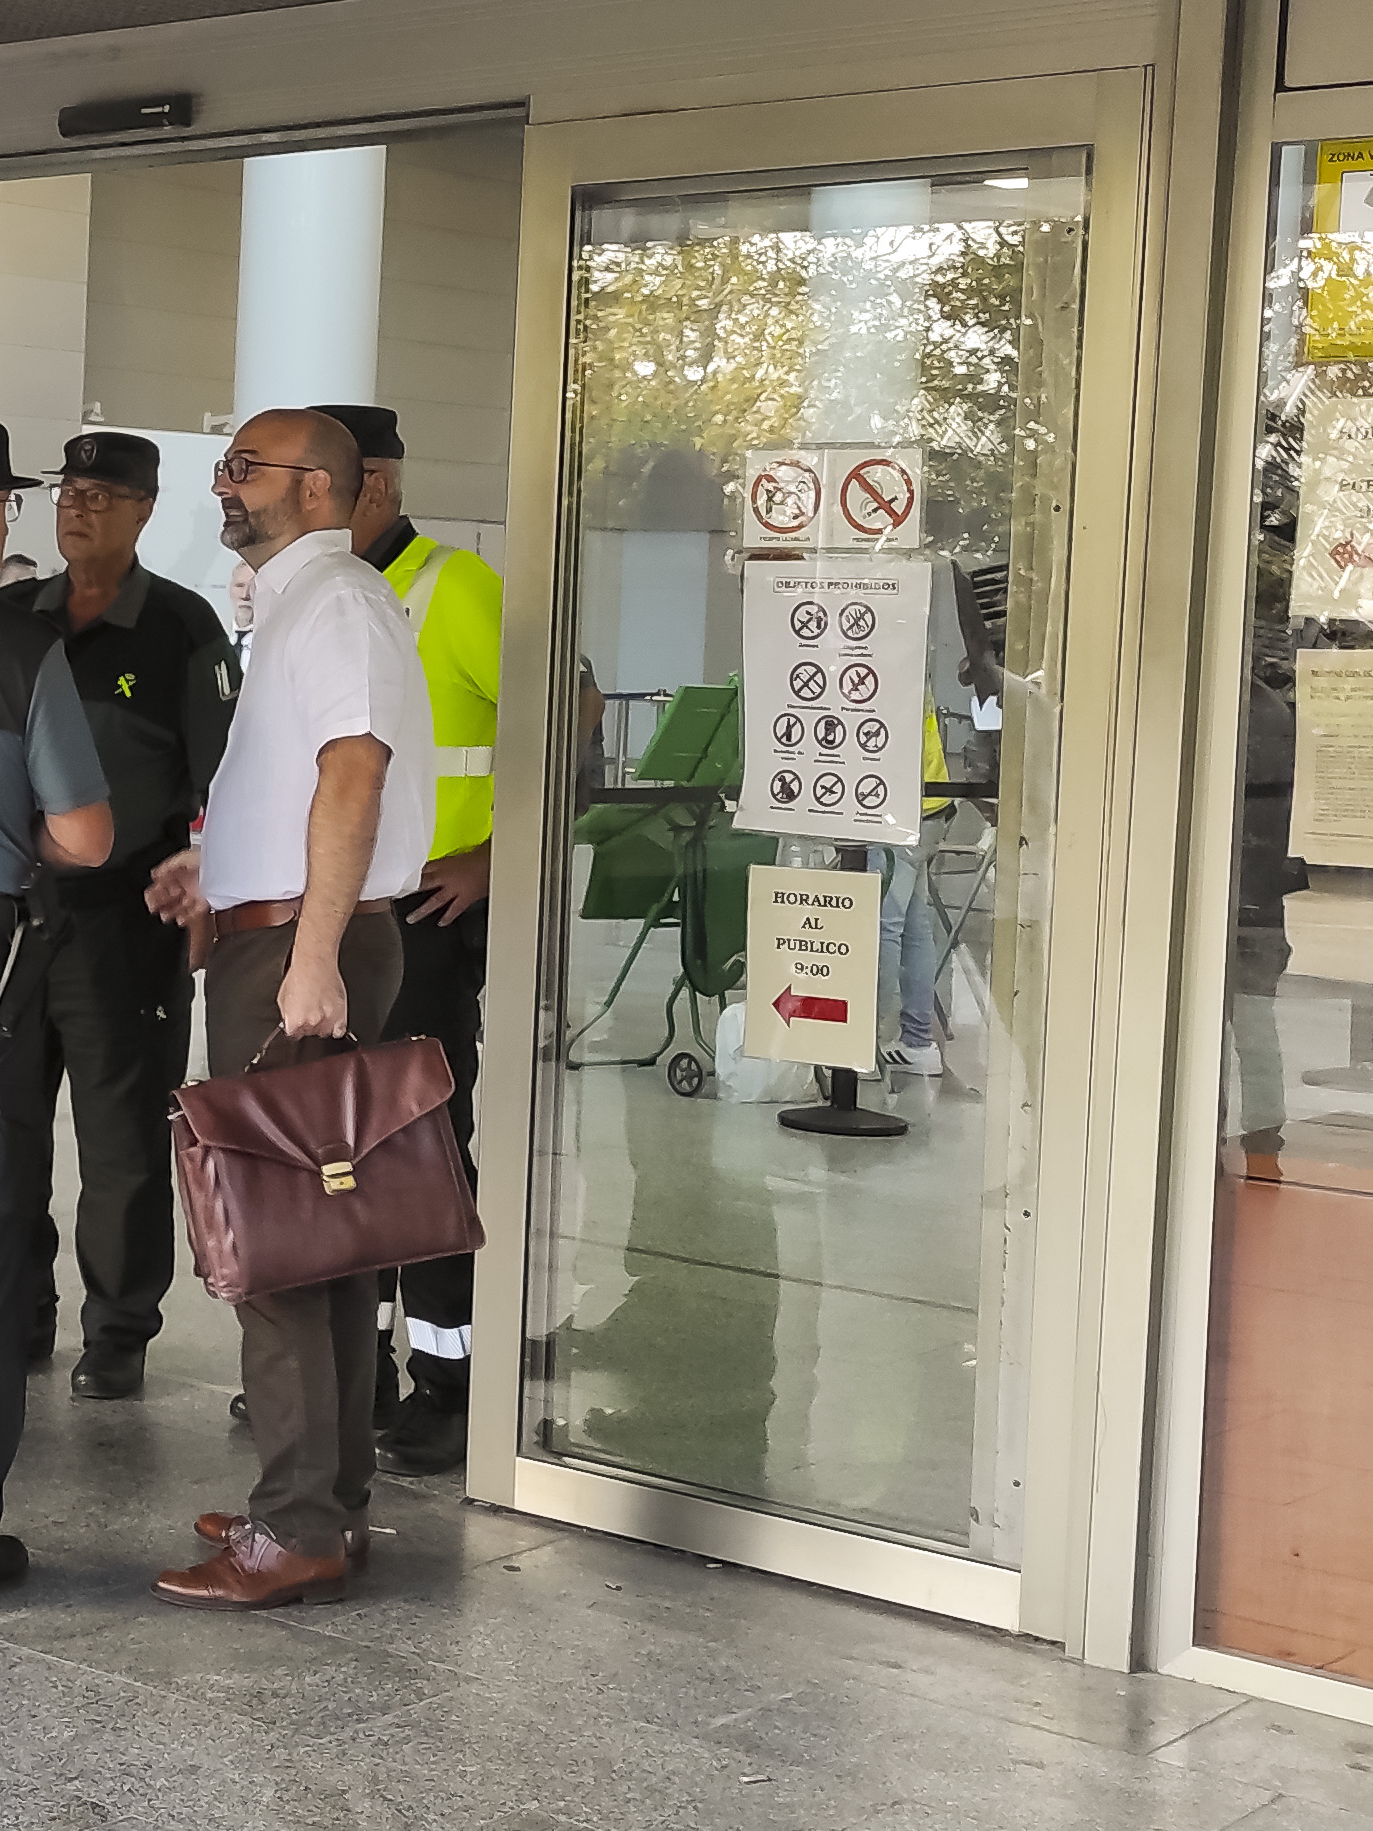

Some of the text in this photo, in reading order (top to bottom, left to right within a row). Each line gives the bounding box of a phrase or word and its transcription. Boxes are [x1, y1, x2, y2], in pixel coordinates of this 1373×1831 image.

[1328, 151, 1365, 163] ZONA
[772, 891, 854, 909] HORARIO
[801, 917, 824, 930] AL
[776, 937, 850, 955] PUBLICO
[794, 962, 830, 977] 9:00
